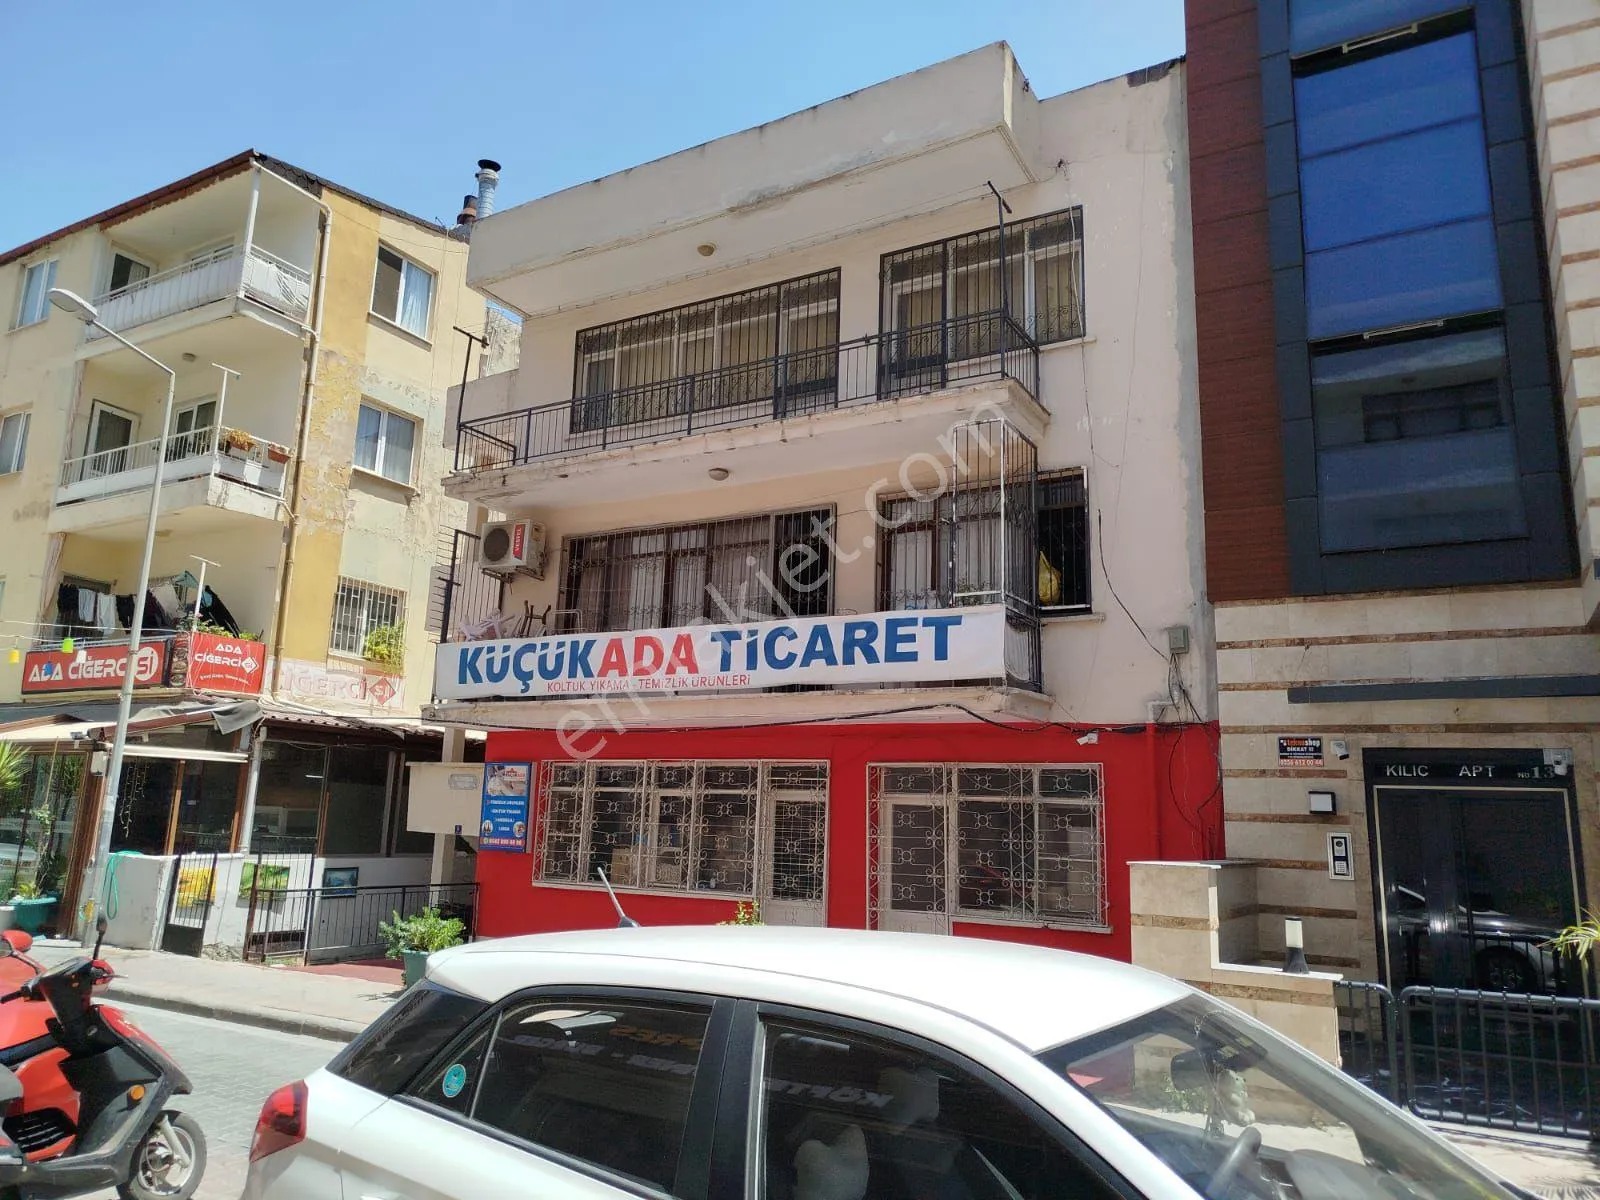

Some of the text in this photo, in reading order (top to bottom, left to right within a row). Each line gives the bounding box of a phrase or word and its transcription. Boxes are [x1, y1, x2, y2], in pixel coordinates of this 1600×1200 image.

[216, 643, 243, 655] ADA
[710, 615, 963, 672] TİCARET
[136, 651, 155, 676] Sİ
[547, 678, 586, 692] KOLTUK
[691, 674, 751, 687] ÜRÜNLERİ
[1386, 765, 1429, 777] KILIC
[1458, 765, 1495, 777] APT
